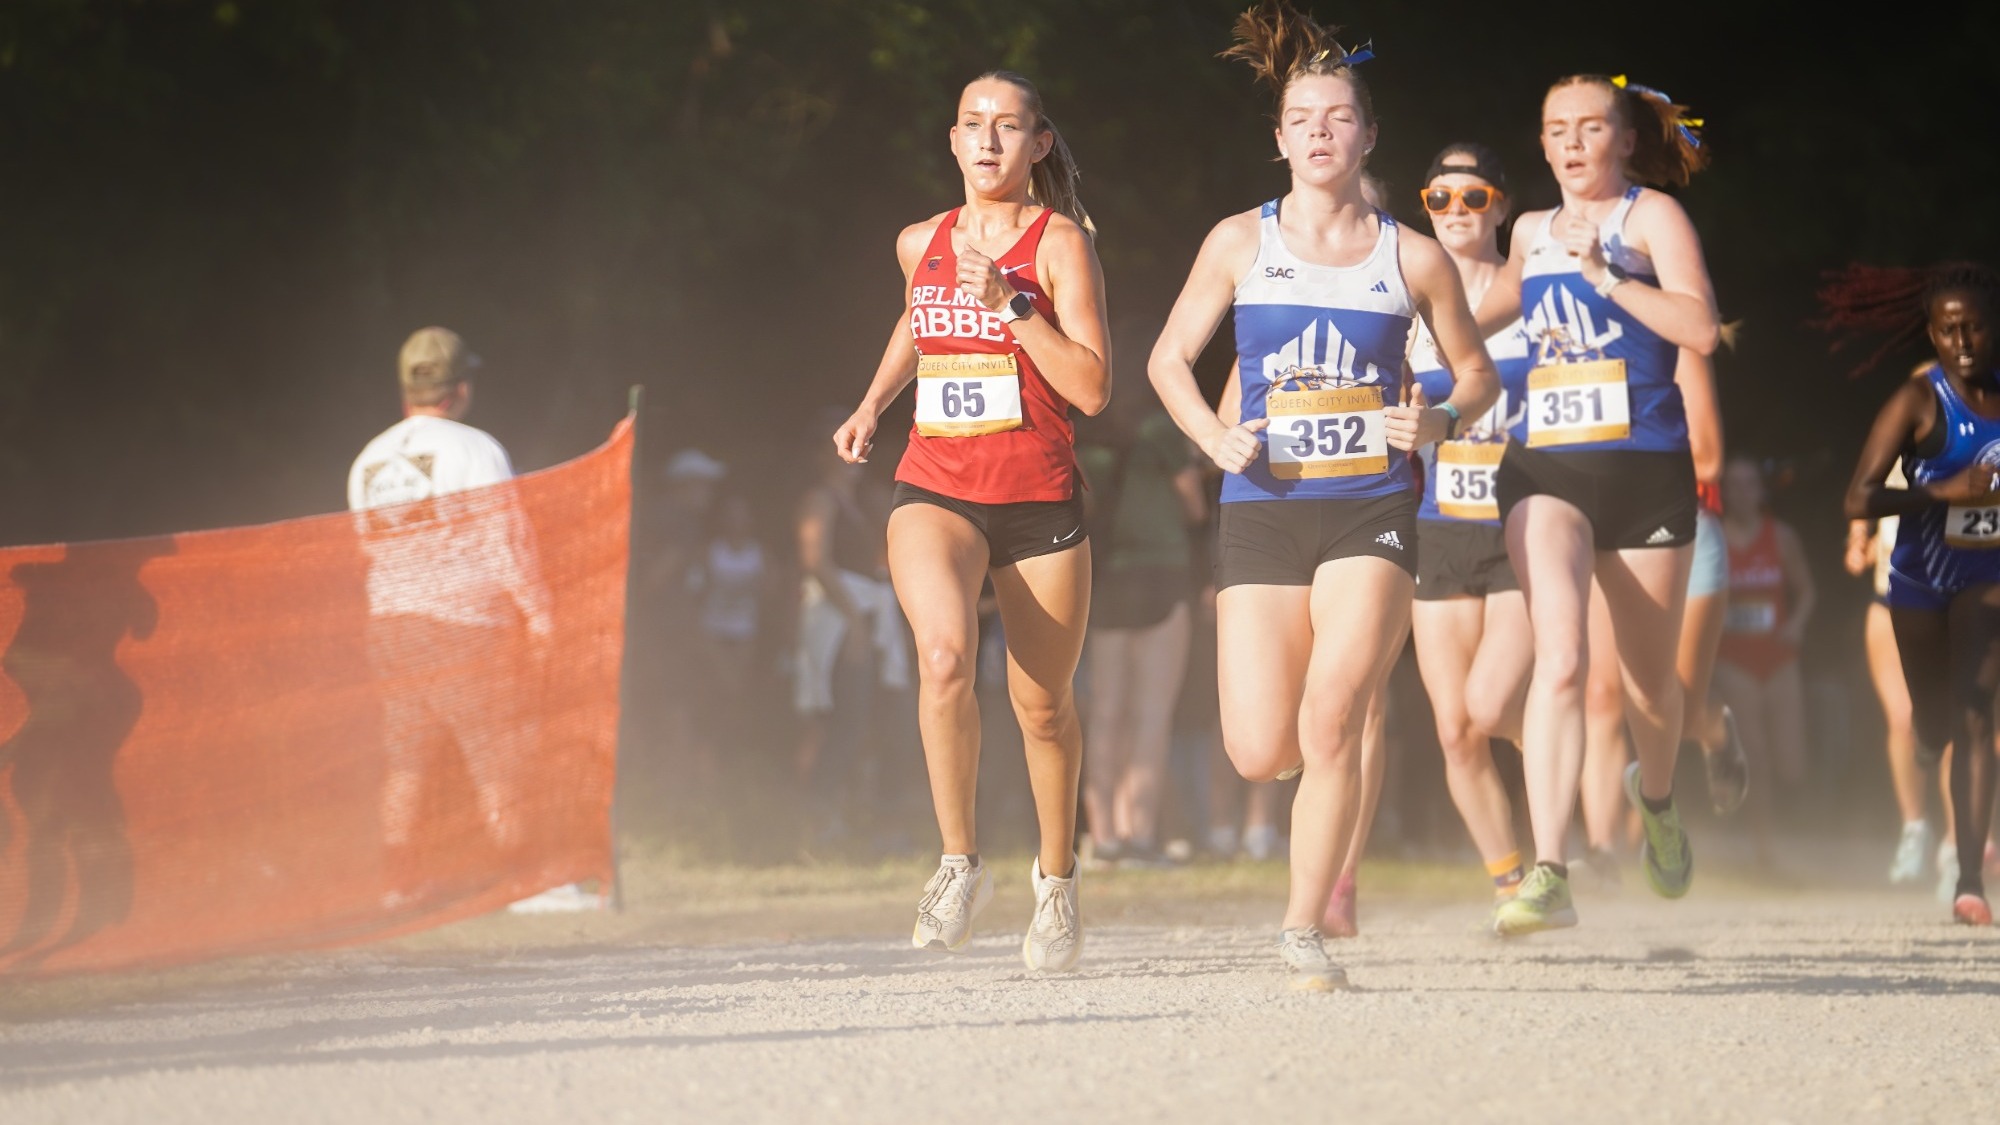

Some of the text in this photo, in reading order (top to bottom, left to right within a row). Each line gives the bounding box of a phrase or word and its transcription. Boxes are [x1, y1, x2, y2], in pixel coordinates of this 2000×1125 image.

[1264, 266, 1295, 280] SAC
[911, 285, 1038, 309] BELM
[910, 306, 1022, 345] ABBE
[918, 359, 1014, 371] QUEEN CITY INVITE
[942, 381, 985, 418] 65
[1270, 393, 1382, 409] QUEEN CITY INVITE
[1542, 387, 1604, 426] 351
[1290, 415, 1367, 457] 352
[1963, 509, 1998, 534] 23
